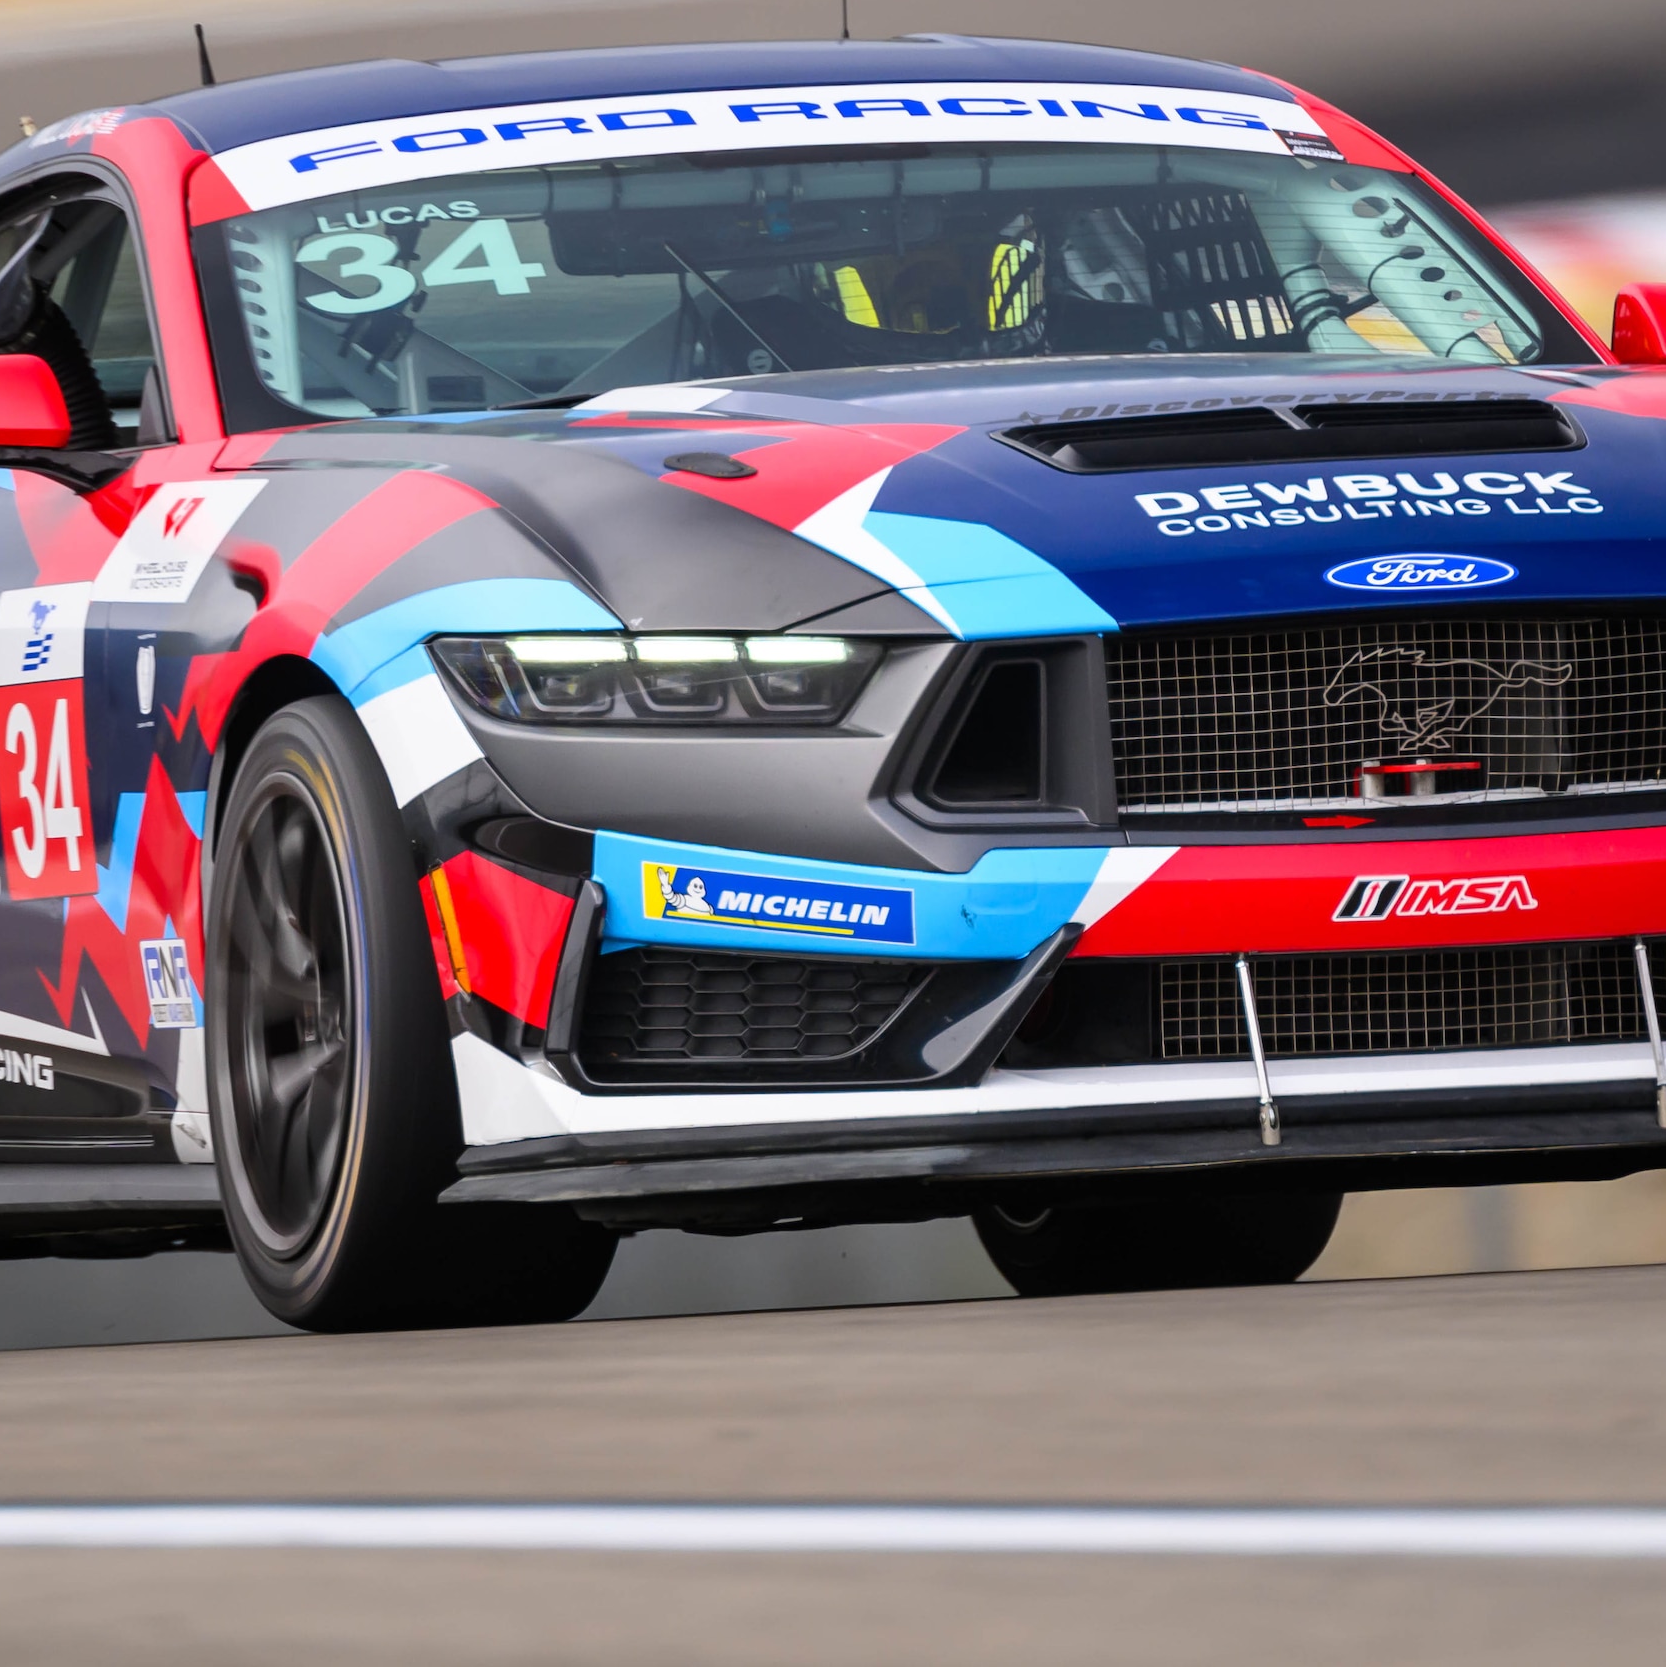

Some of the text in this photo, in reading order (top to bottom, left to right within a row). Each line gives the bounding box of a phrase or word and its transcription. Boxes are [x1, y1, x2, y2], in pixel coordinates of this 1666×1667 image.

[289, 98, 1270, 173] FORD RACING
[317, 200, 480, 234] LUCAS
[295, 218, 547, 314] 34
[1134, 471, 1591, 518] DEWBUCK
[1156, 497, 1605, 537] CONSULTING LLC
[1366, 558, 1478, 585] Ford
[5, 698, 83, 879] 34
[717, 890, 890, 926] MICHELIN
[1396, 876, 1536, 916] IMSA
